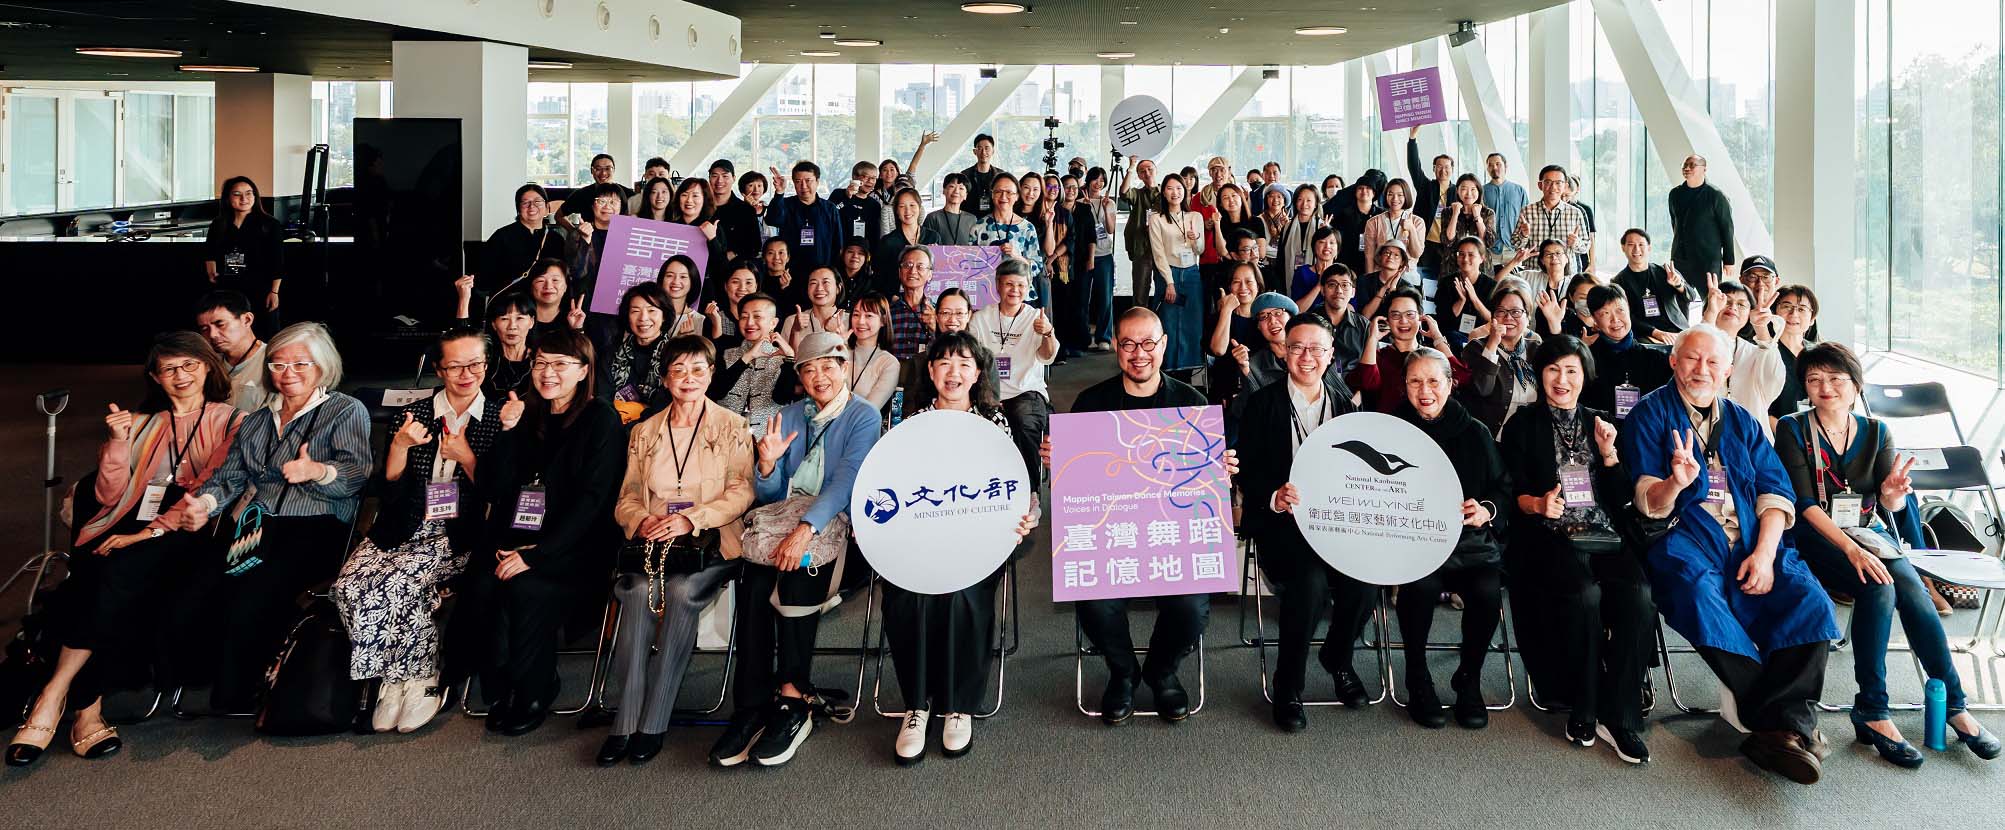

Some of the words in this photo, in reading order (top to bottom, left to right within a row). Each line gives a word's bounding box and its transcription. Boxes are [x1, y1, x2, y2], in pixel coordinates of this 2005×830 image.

[1345, 474, 1372, 483] National
[905, 477, 1019, 508] 文化部
[1345, 483, 1375, 491] CENTER
[1063, 494, 1100, 505] Mapping
[1103, 492, 1133, 502] Taiwan
[1134, 491, 1162, 500] Dance
[1163, 488, 1206, 498] Memories
[913, 508, 954, 520] MINISTRY
[956, 507, 968, 517] OF
[970, 504, 1011, 515] CULTURE
[1063, 504, 1091, 514] Voices
[1092, 504, 1100, 512] in
[1102, 502, 1138, 513] Dialogue
[1063, 517, 1223, 552] 臺灣舞蹈
[1063, 552, 1225, 588] 記憶地圖
